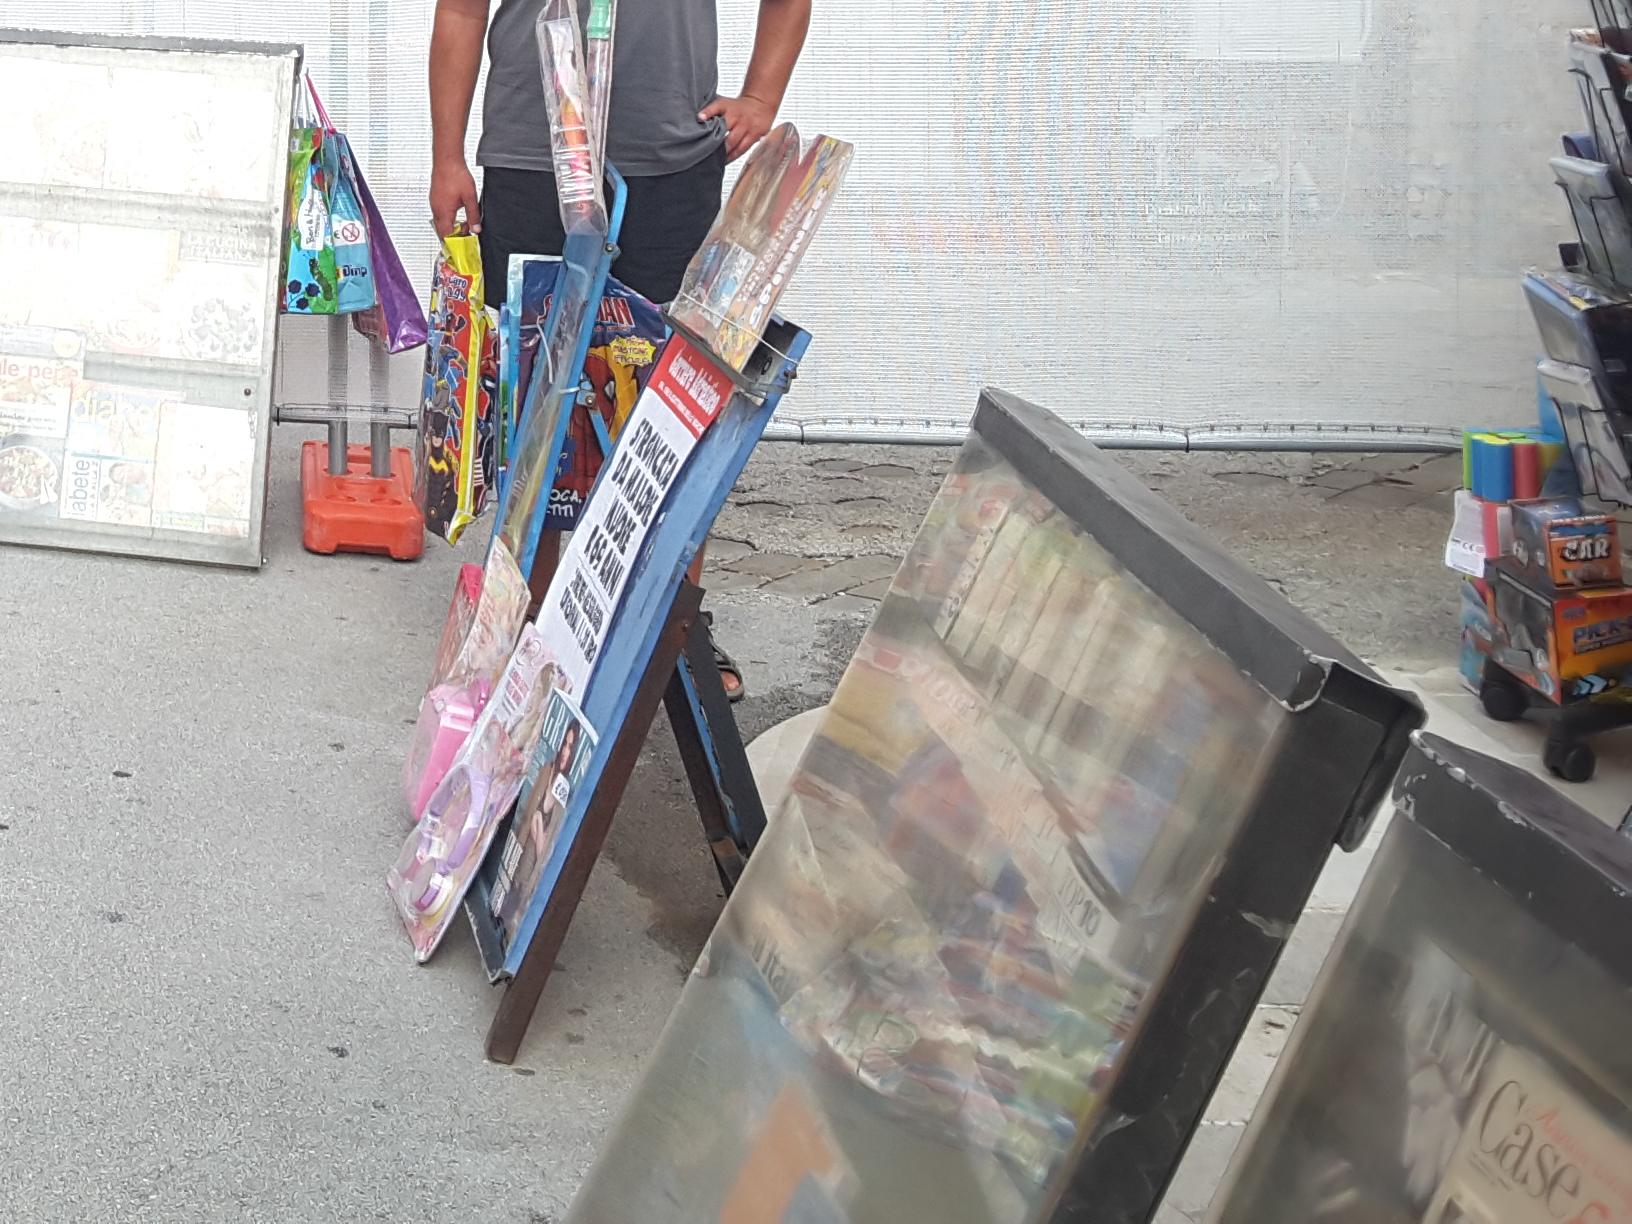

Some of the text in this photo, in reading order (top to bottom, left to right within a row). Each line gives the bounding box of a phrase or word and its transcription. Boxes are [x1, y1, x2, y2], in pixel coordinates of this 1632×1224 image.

[28, 363, 79, 383] pepe
[629, 417, 679, 492] STRONCATA
[611, 450, 659, 528] DA MALORE
[589, 533, 608, 571] 69
[603, 496, 637, 555] MUORE
[1563, 535, 1610, 561] CAR
[598, 547, 625, 601] ANNI
[1480, 1079, 1582, 1219] Case
